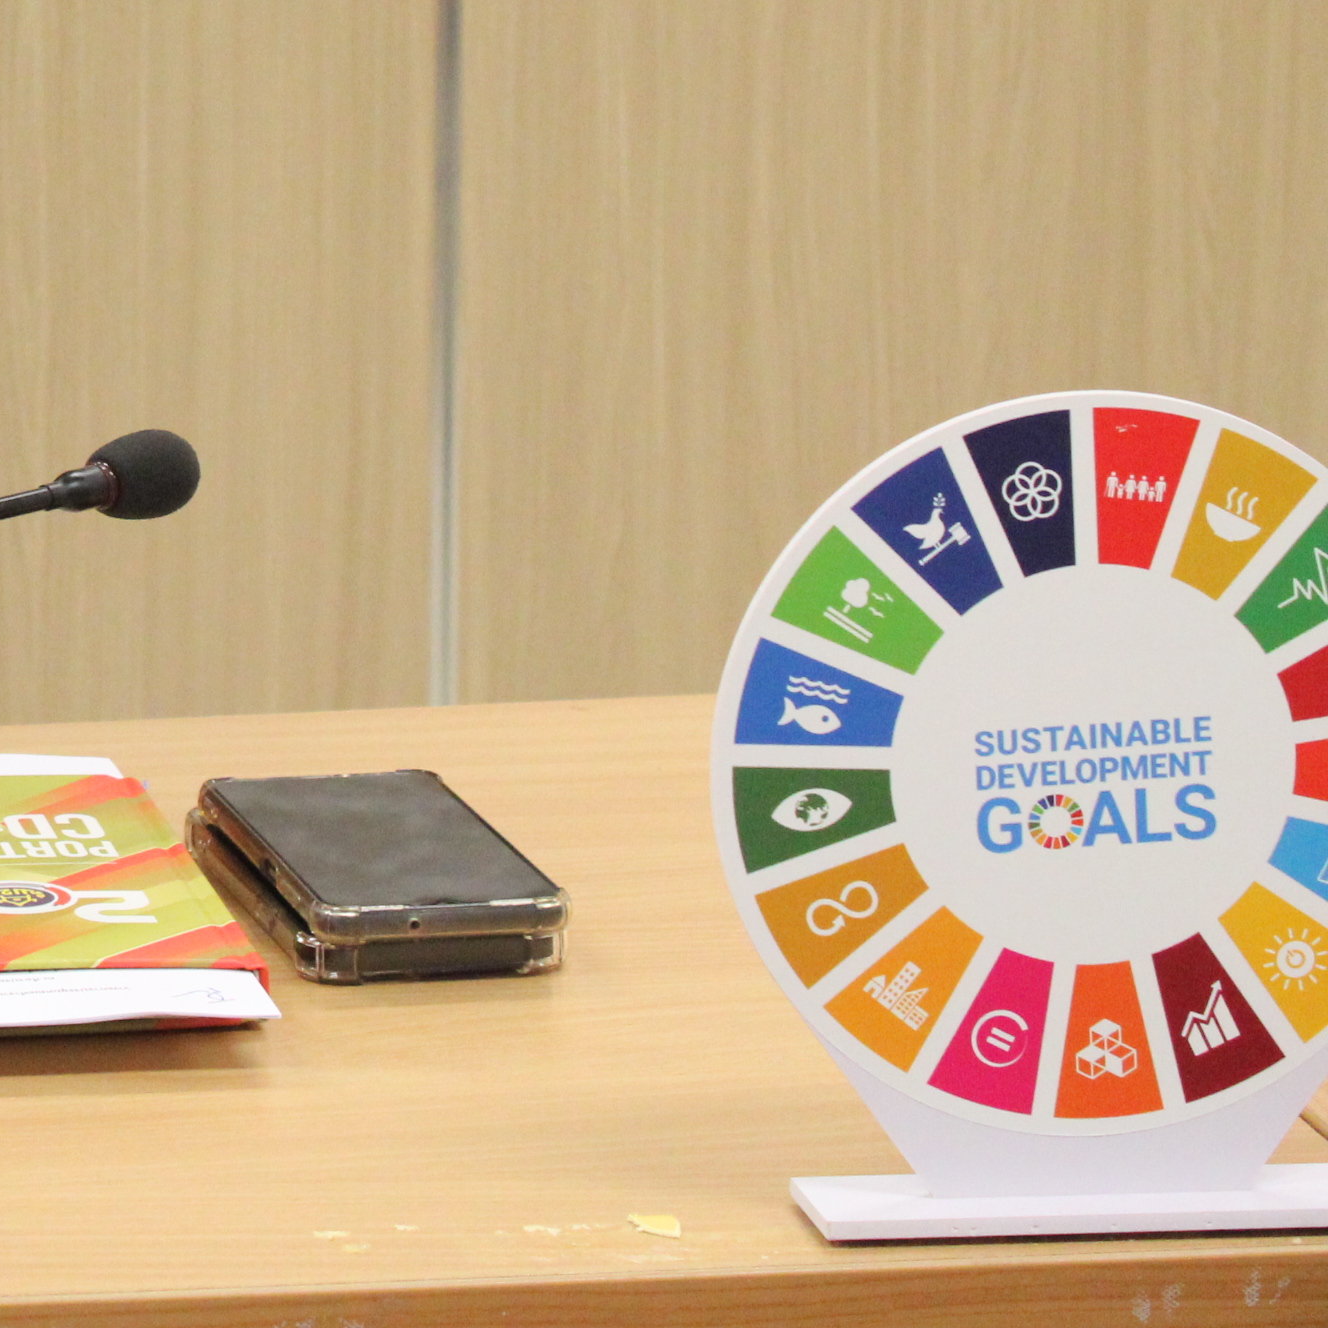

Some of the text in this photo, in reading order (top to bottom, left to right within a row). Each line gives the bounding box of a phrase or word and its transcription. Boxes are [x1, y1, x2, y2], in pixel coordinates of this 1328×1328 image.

[973, 715, 1212, 758] SUSTAINABLE
[975, 750, 1213, 792] DEVELOPMENT
[3, 812, 102, 840] CD
[976, 782, 1218, 854] GOALS
